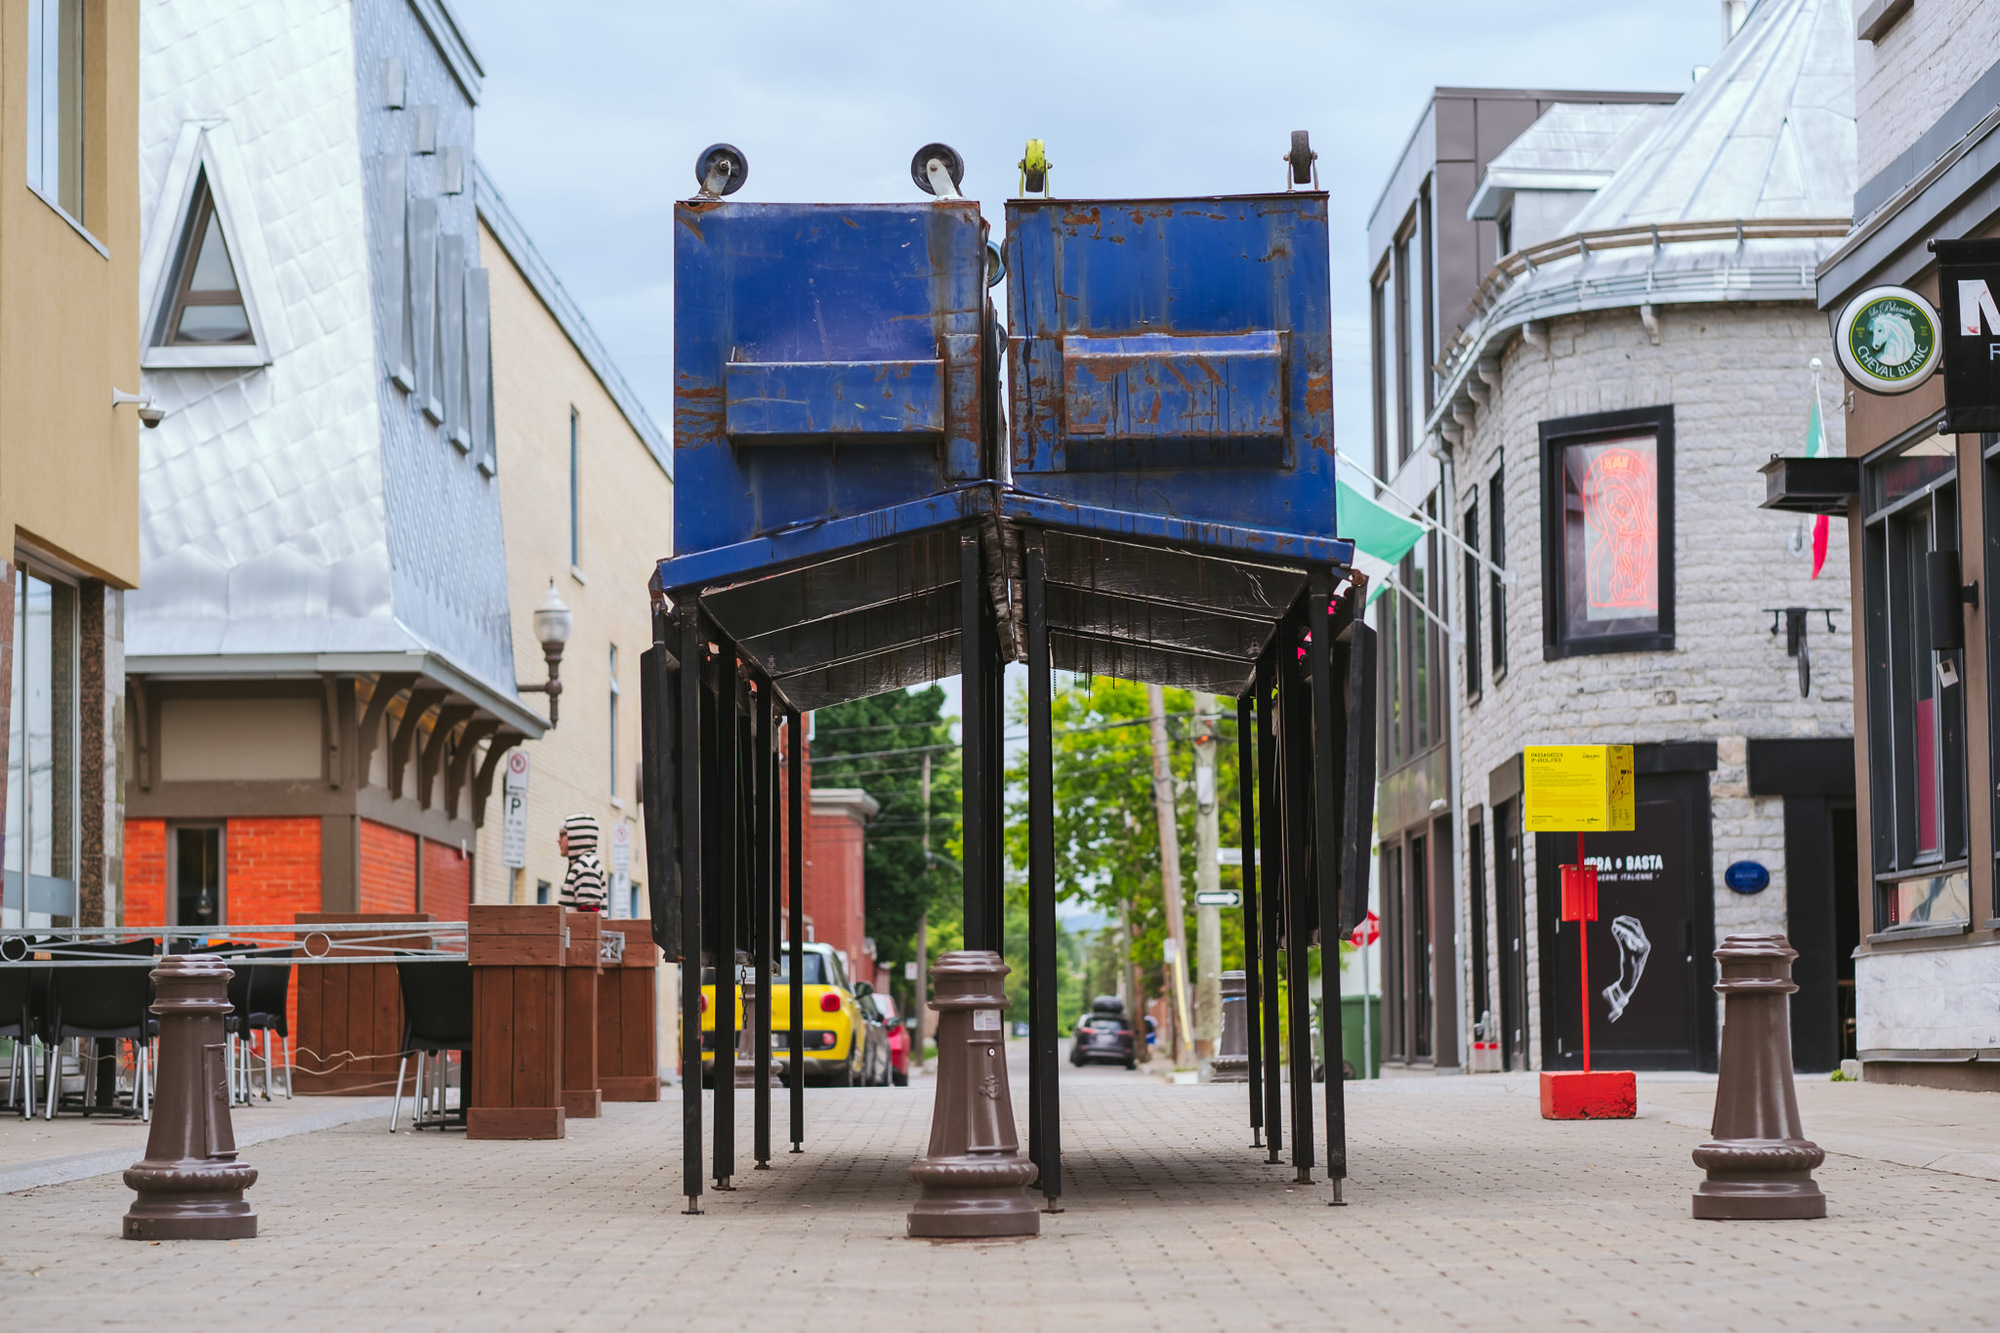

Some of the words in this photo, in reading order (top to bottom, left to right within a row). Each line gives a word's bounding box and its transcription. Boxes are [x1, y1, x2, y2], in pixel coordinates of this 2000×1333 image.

[1857, 345, 1896, 378] CHEVAL
[1897, 344, 1929, 377] BLANC
[511, 797, 522, 816] P
[1626, 854, 1664, 871] BASTA
